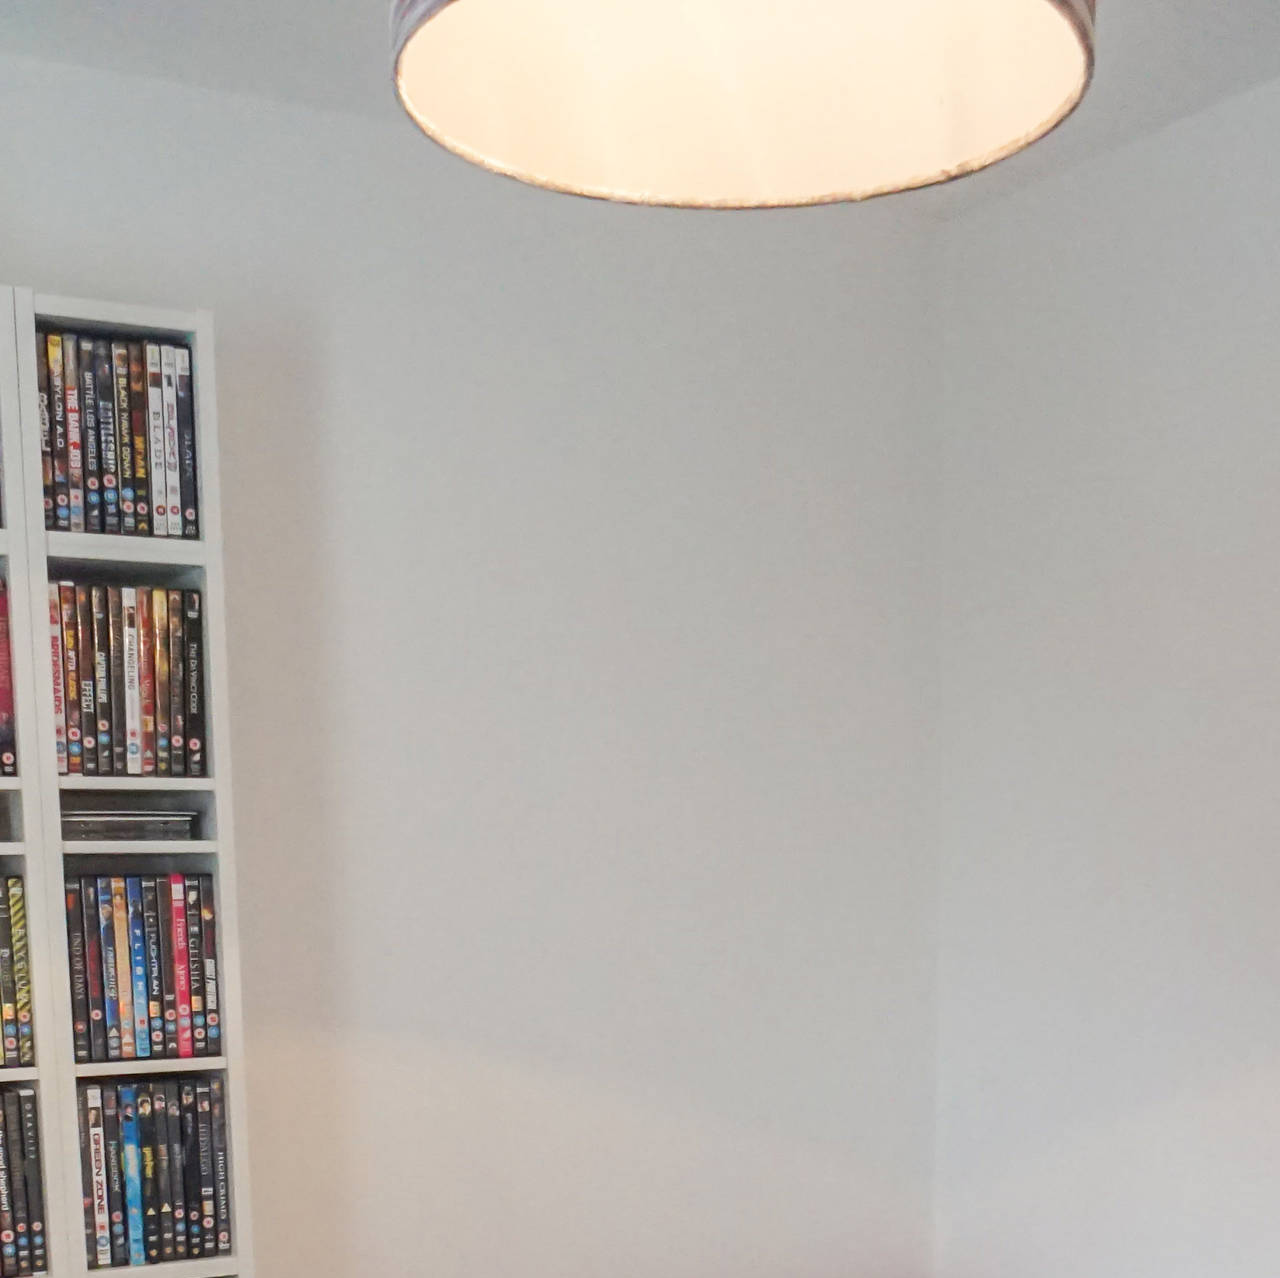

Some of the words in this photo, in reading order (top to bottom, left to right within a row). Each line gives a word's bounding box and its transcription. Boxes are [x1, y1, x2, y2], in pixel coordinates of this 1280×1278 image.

[67, 389, 78, 410] THE
[84, 372, 93, 405] BATTLE
[118, 378, 127, 408] BLACK
[86, 409, 95, 427] LOS
[87, 429, 97, 470] ANGELES
[127, 634, 136, 690] CHANGELING
[82, 680, 93, 714] EFFECT
[25, 1103, 35, 1159] GRAVITY
[92, 1133, 102, 1177] GREEN
[97, 1180, 105, 1215] ZONE
